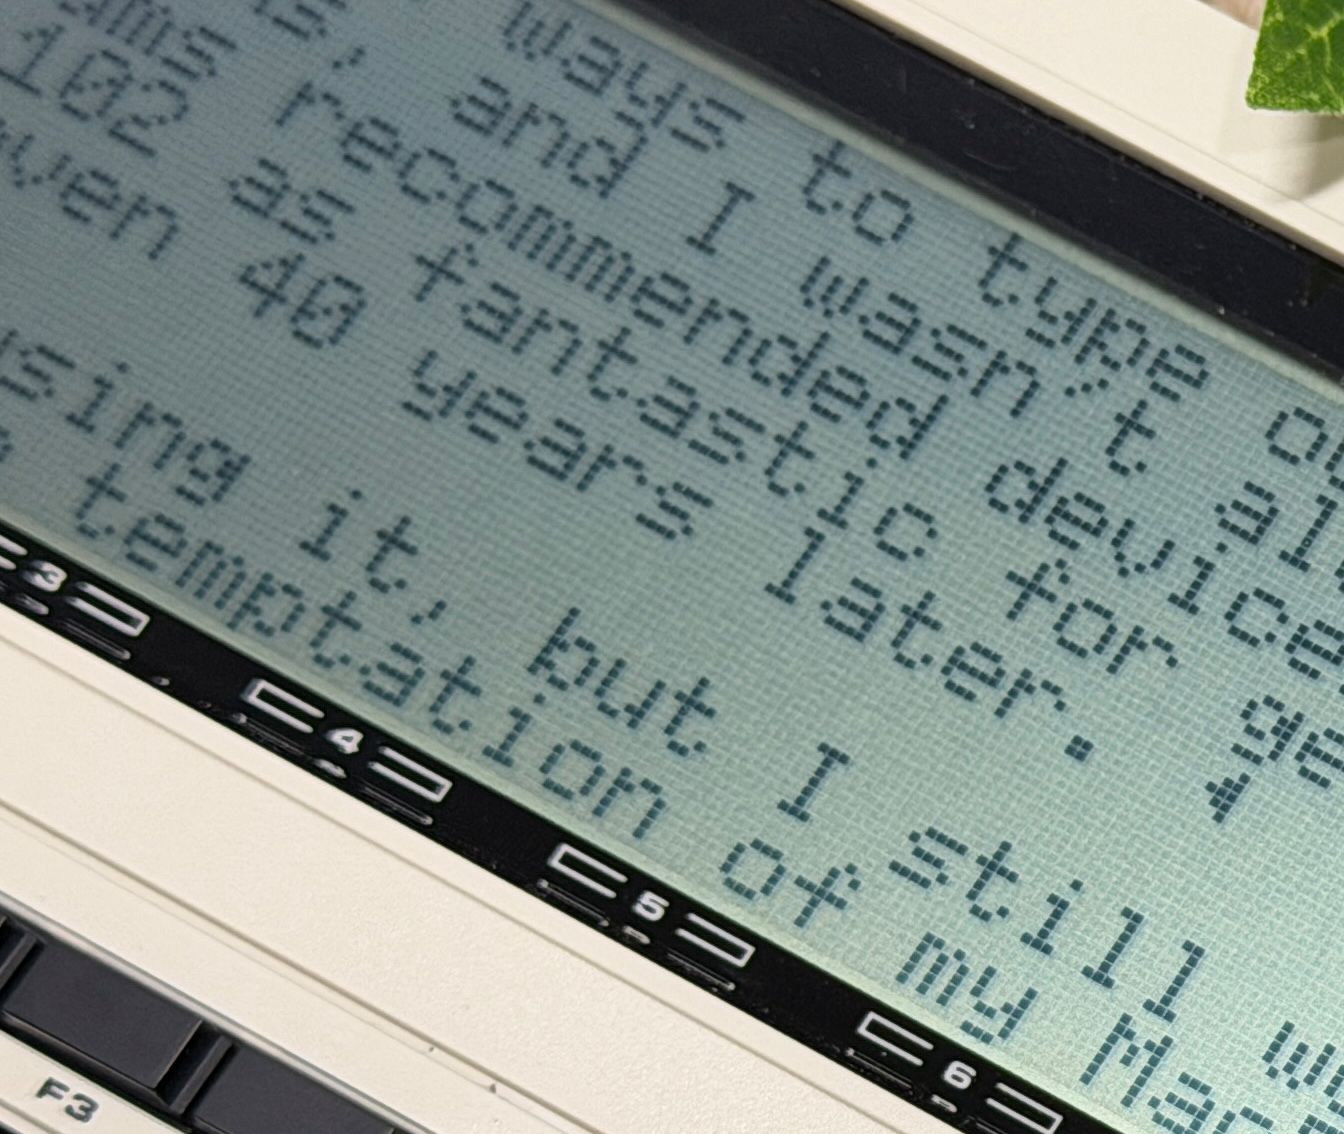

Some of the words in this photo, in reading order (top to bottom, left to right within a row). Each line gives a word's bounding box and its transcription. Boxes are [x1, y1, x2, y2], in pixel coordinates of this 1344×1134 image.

[273, 59, 950, 462] recommended
[448, 74, 648, 200] and
[683, 179, 756, 257] I
[797, 254, 1157, 480] wasn't
[502, 12, 746, 154] ways
[800, 139, 915, 247] to
[976, 232, 1211, 404] type
[0, 118, 180, 262] ven
[235, 253, 367, 350] 40
[398, 348, 715, 542] years
[761, 524, 1095, 765] later.
[226, 156, 356, 246] as
[412, 242, 939, 563] fantastic
[1003, 556, 1180, 677] for
[0, 330, 251, 508] sing
[296, 487, 448, 627] it,
[524, 604, 717, 759] but
[774, 740, 853, 825] I
[886, 825, 1207, 1025] still
[73, 462, 667, 841] temptation
[717, 836, 862, 929] of
[893, 930, 1039, 1044] my
[325, 727, 363, 755] 4
[34, 1076, 100, 1124] F3
[630, 889, 671, 922] 5
[942, 1059, 978, 1091] 6
